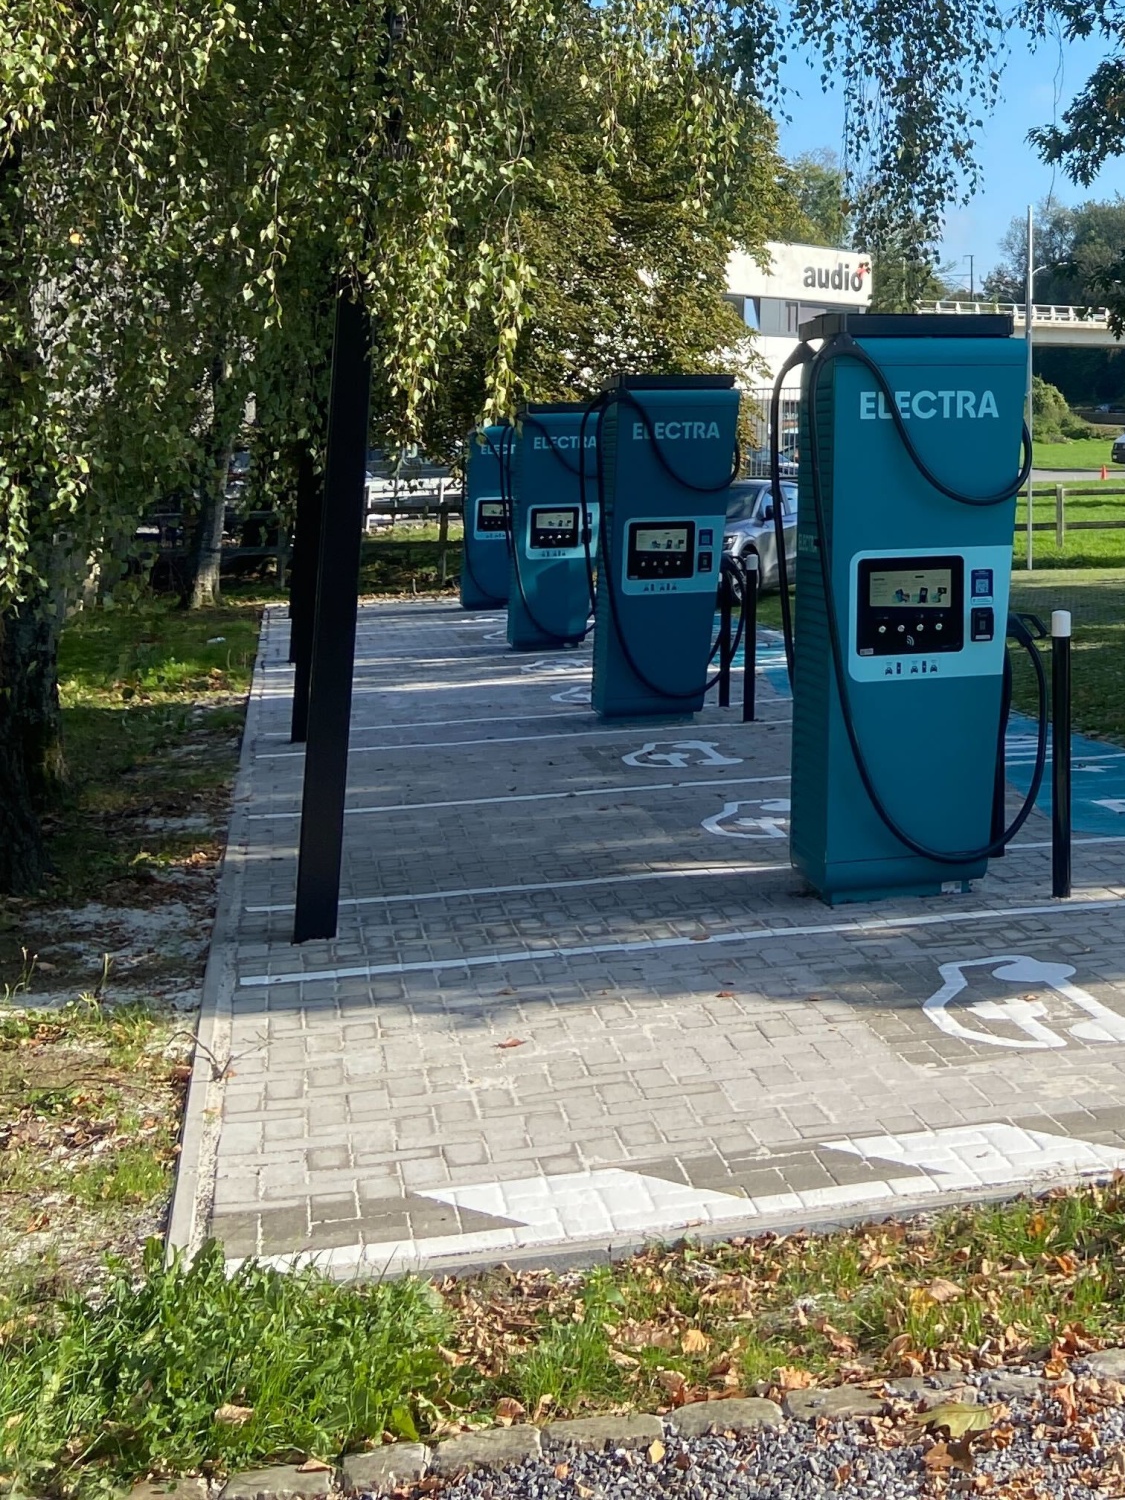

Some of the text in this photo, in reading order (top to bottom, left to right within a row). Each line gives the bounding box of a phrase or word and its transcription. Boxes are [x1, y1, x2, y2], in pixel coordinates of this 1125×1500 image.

[859, 390, 999, 420] ELECTRA
[632, 421, 720, 440] ELECTRA
[481, 444, 516, 455] ELECT
